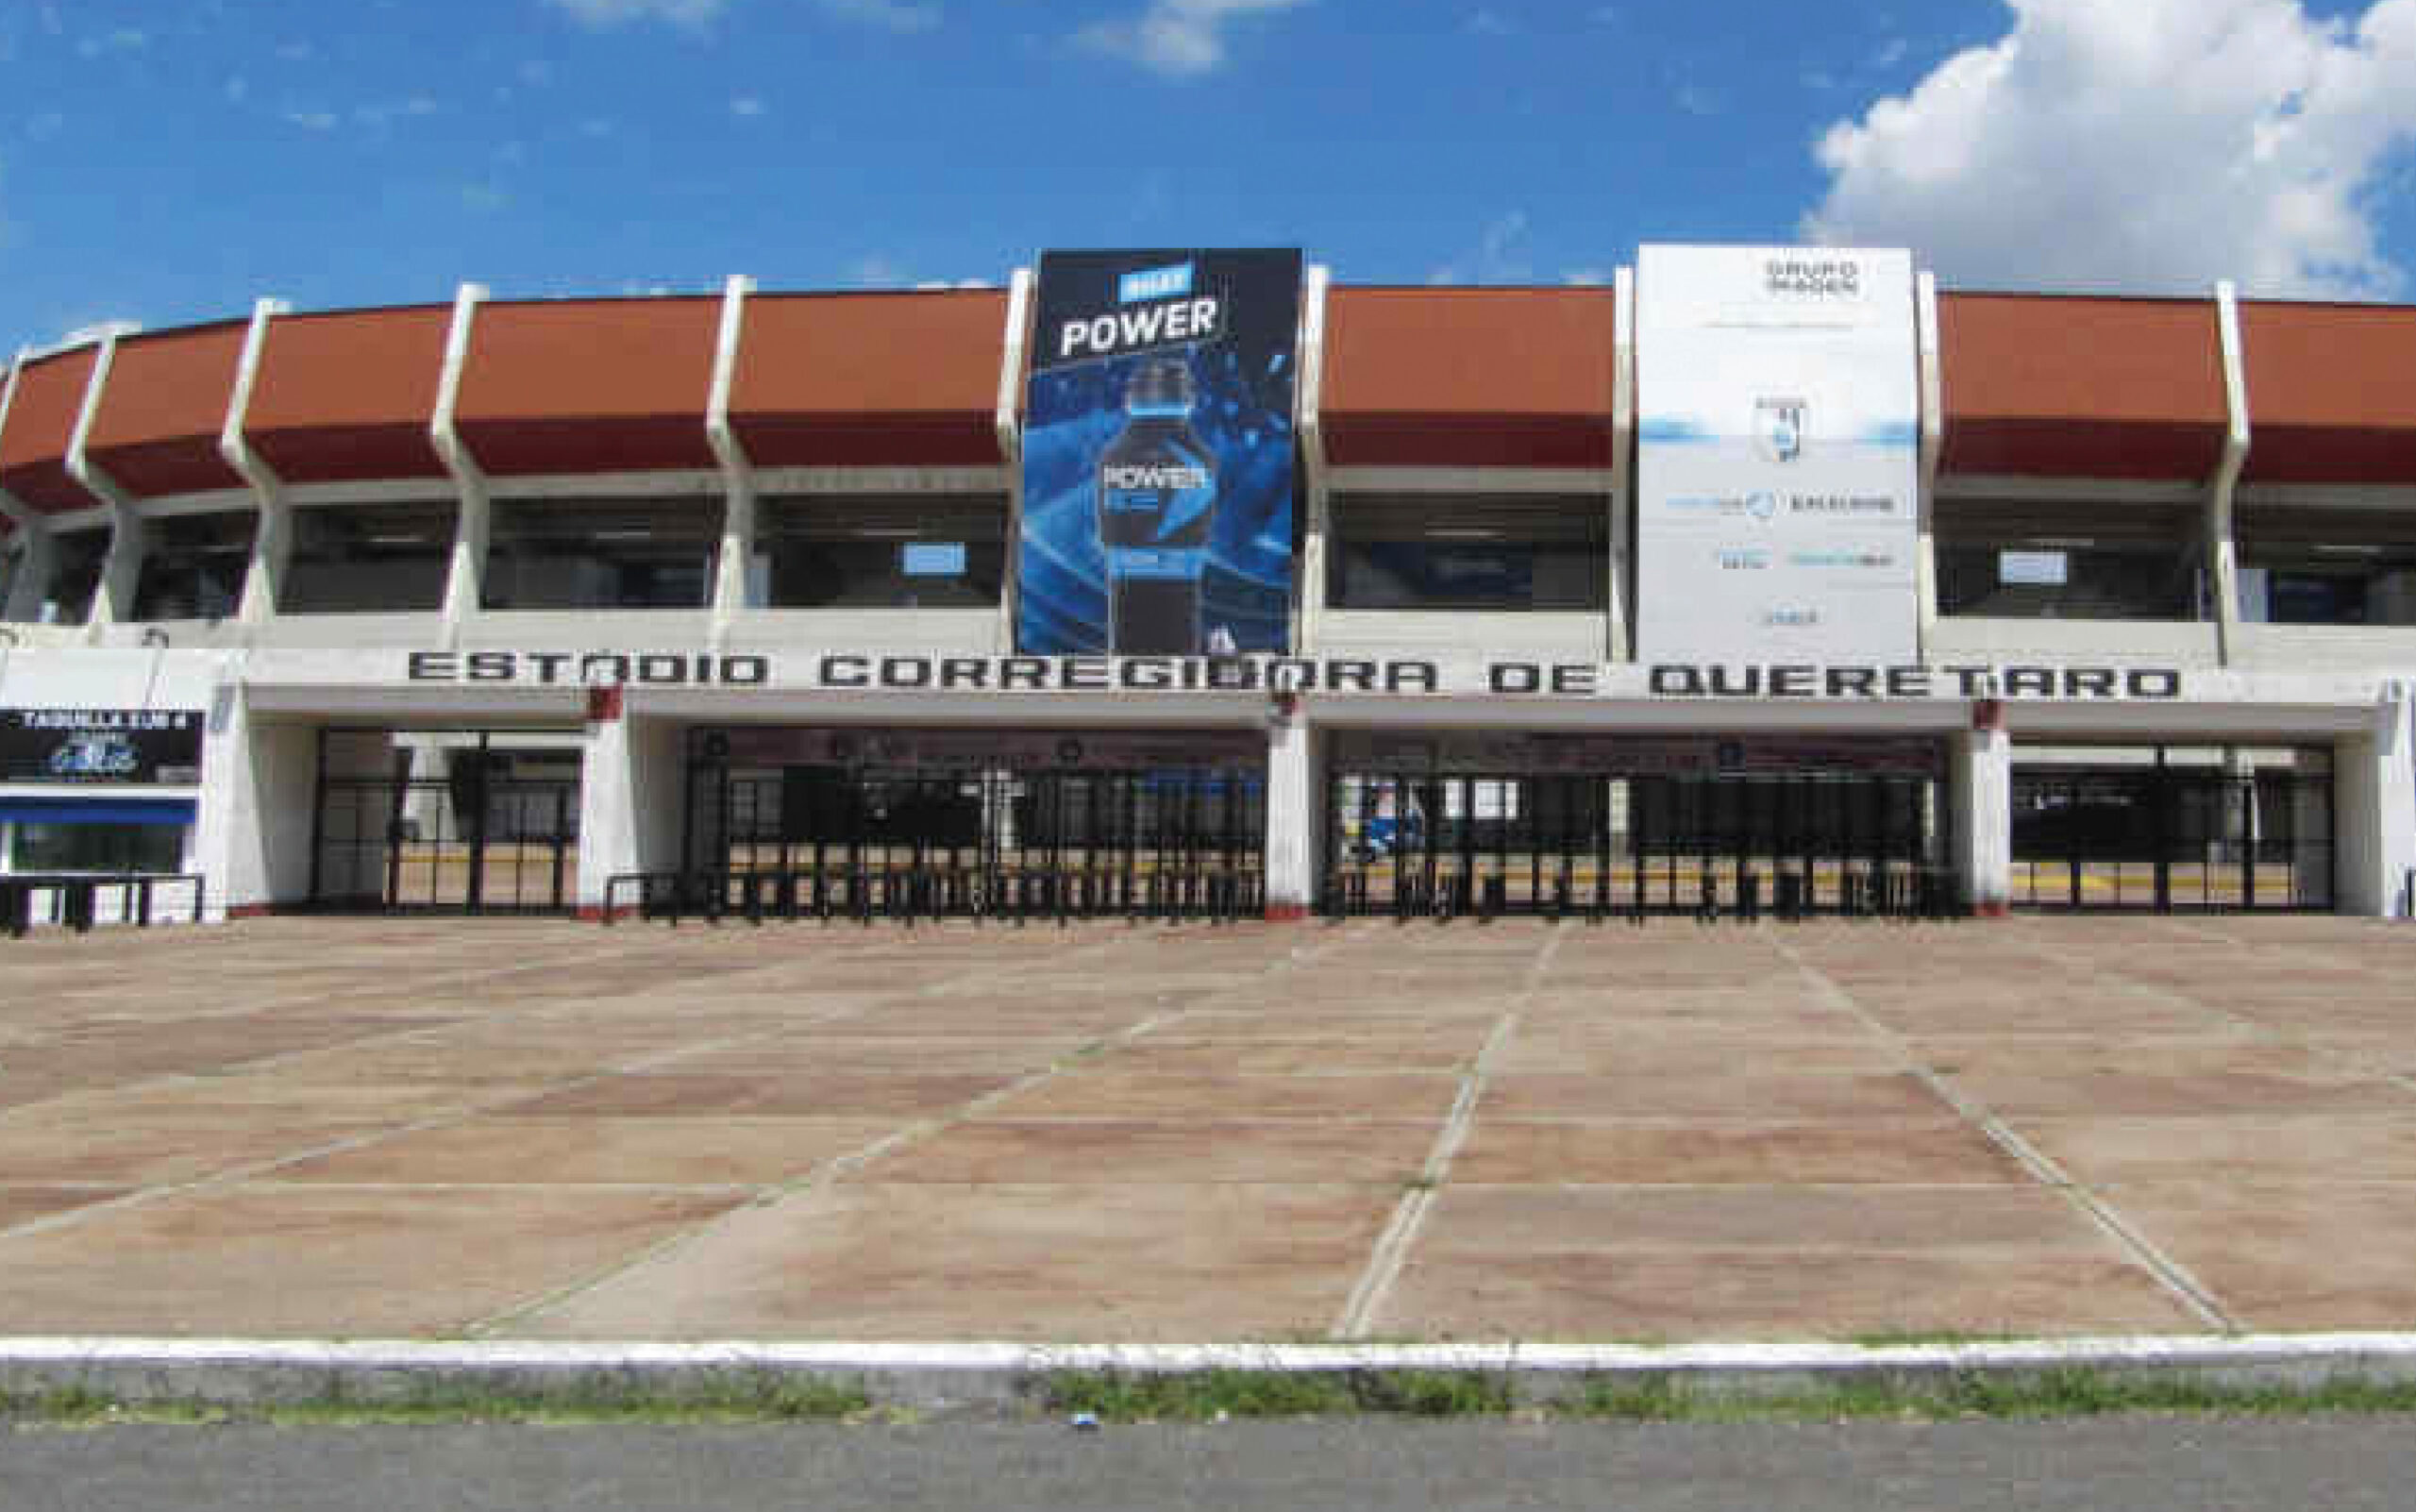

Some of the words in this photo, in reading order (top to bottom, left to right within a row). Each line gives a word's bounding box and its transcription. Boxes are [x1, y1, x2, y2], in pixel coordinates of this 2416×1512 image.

[1061, 298, 1216, 356] POWER
[409, 652, 768, 683] ESTADIO
[820, 656, 1437, 694] CORREGIDORA
[1489, 664, 1596, 694] DE
[1648, 664, 2181, 697] QUERETARO
